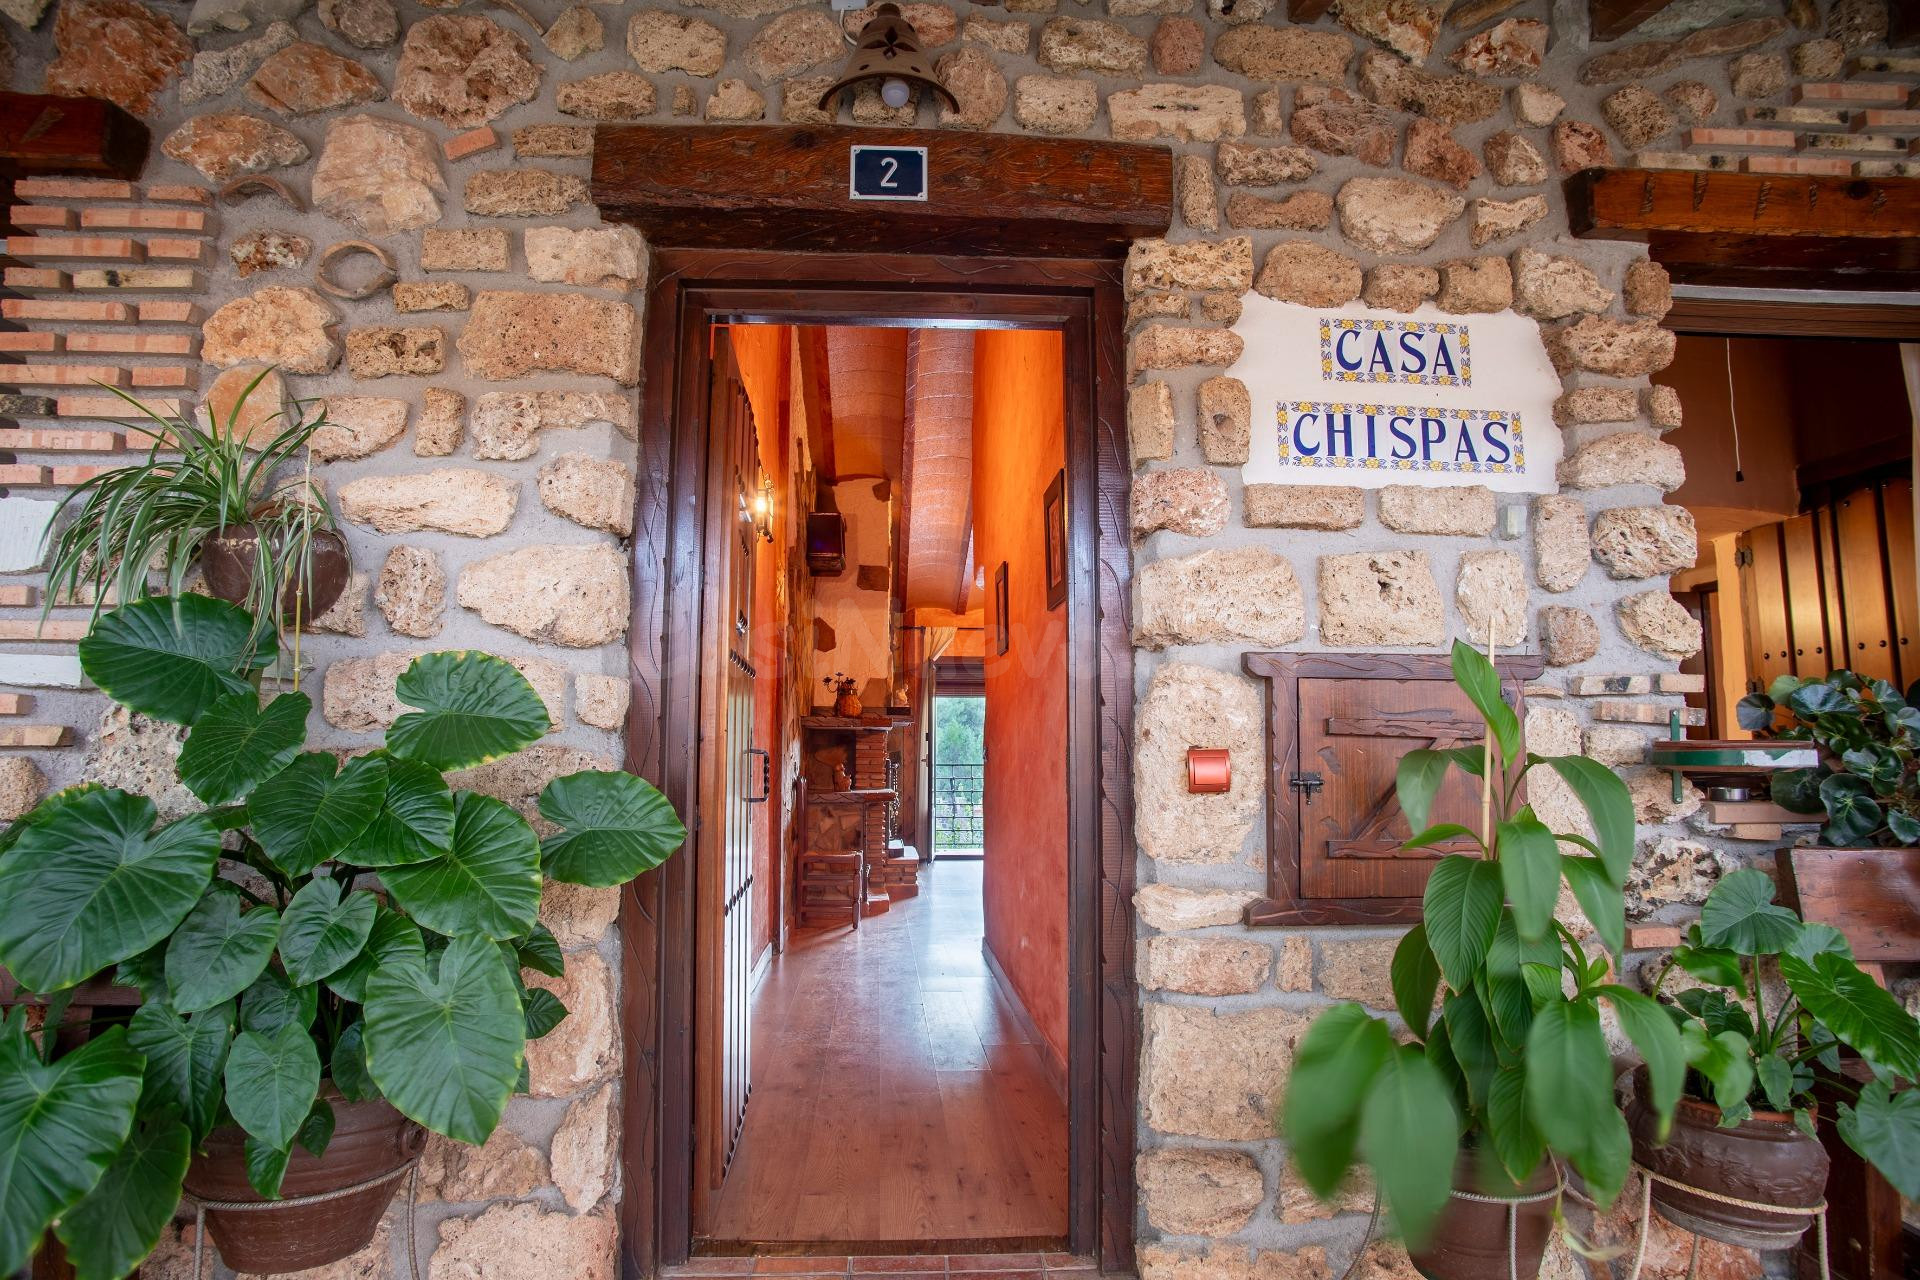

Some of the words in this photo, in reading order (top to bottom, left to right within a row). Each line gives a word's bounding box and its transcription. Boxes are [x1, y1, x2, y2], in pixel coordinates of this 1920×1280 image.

[881, 157, 898, 188] 2
[1335, 329, 1457, 376] CASA
[1292, 412, 1512, 464] CHISPAS
